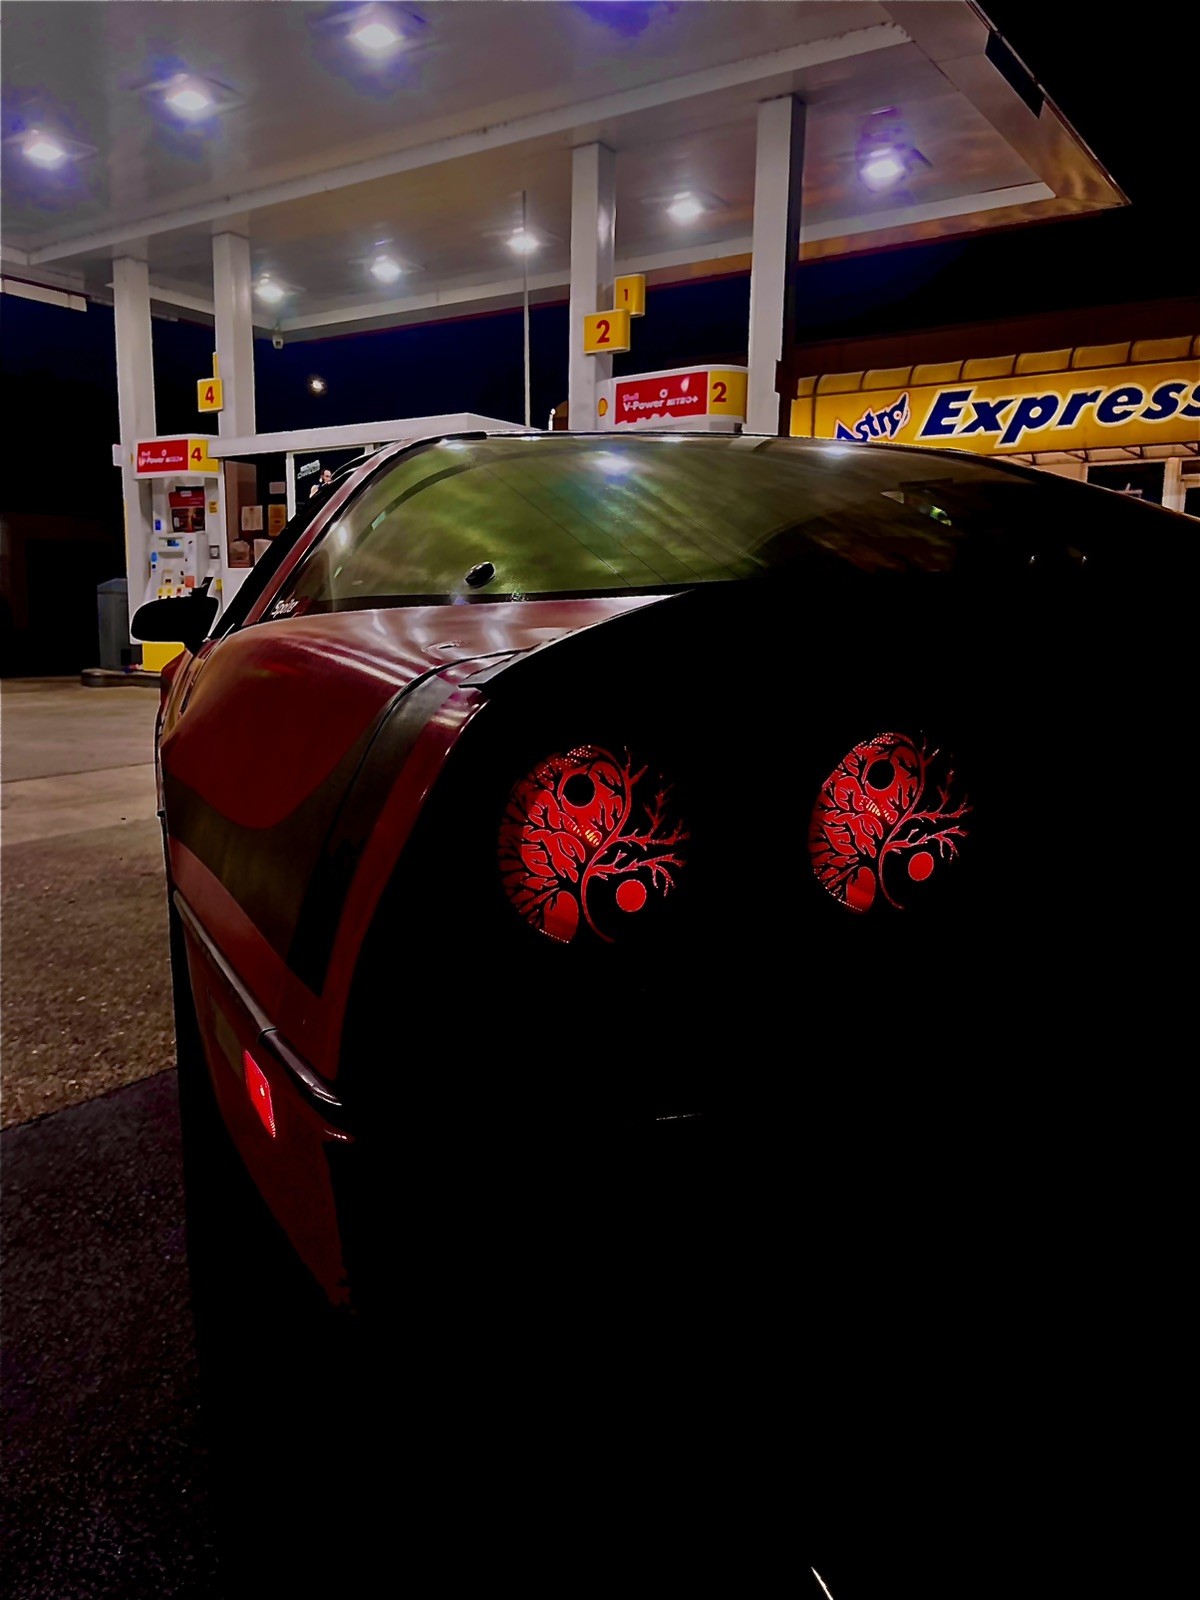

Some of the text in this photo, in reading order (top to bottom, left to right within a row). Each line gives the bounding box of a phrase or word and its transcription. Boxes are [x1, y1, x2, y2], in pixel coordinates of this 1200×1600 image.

[623, 288, 629, 301] 1
[596, 319, 611, 344] 2
[204, 386, 216, 404] 4
[712, 381, 727, 403] 2
[623, 400, 665, 412] V-Power
[918, 380, 1200, 446] Express
[191, 447, 203, 462] 4
